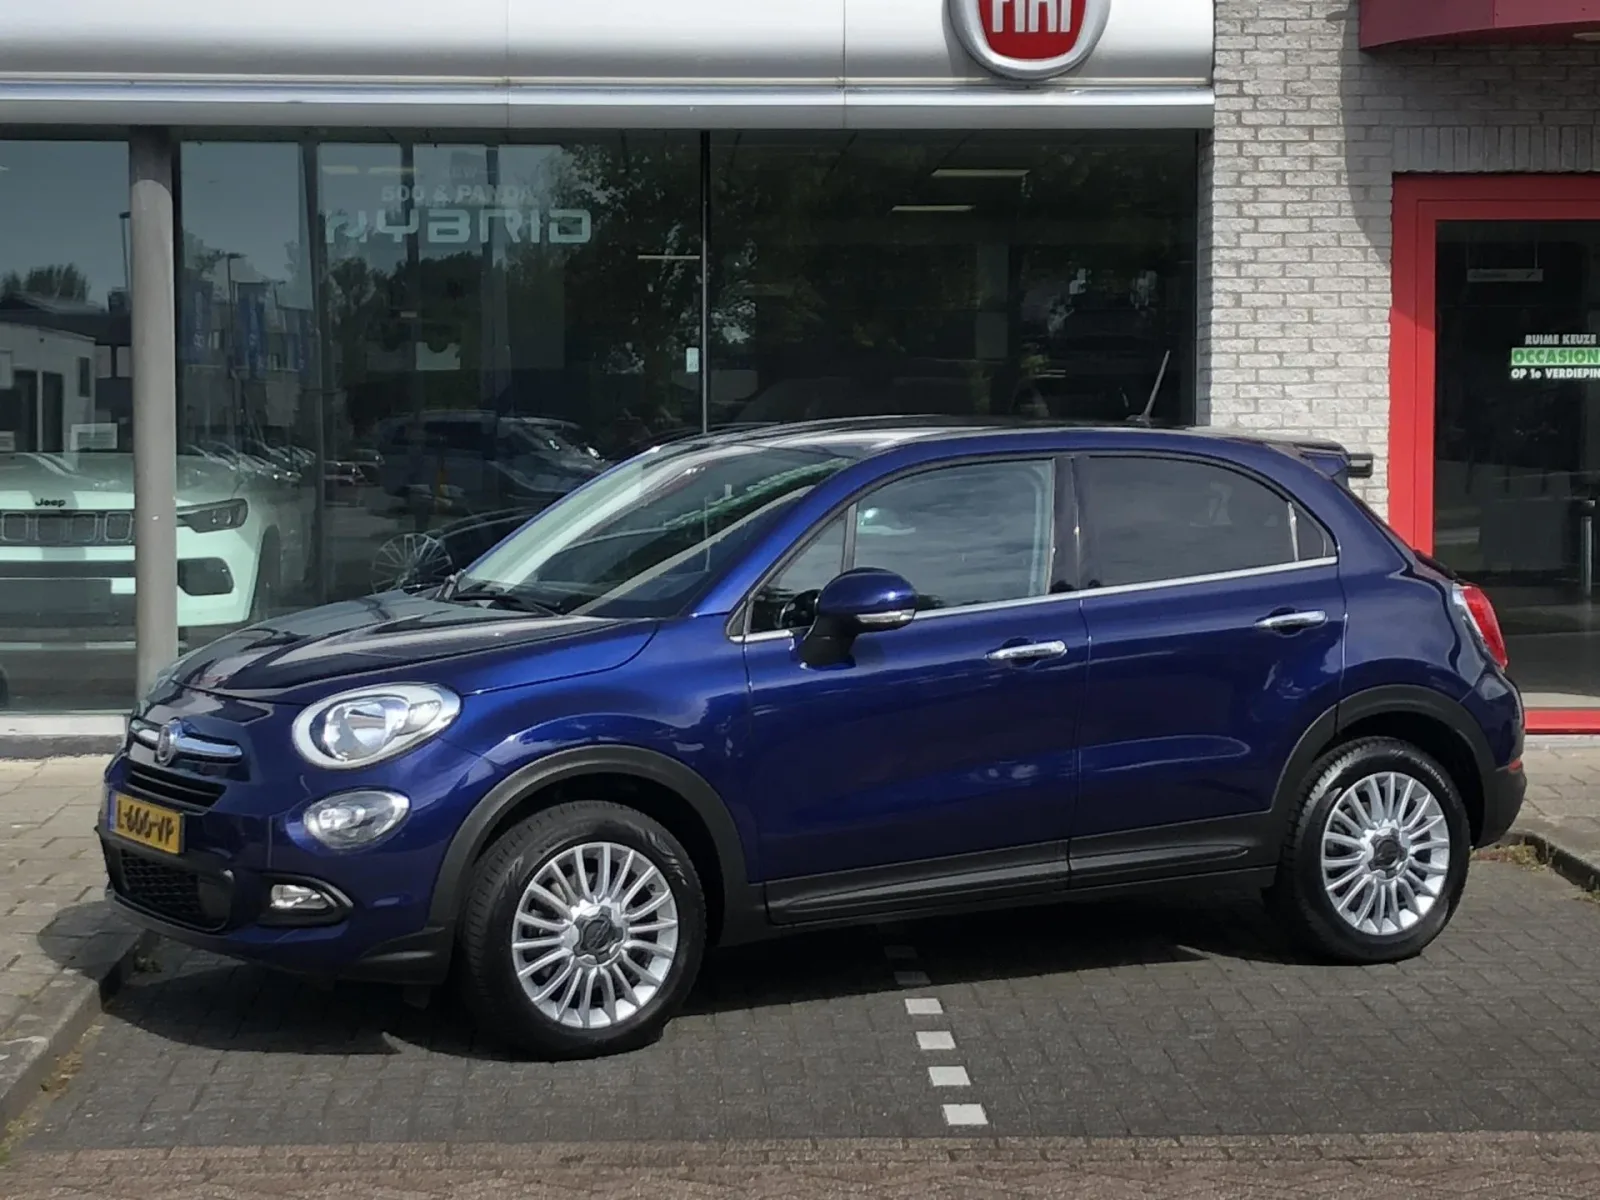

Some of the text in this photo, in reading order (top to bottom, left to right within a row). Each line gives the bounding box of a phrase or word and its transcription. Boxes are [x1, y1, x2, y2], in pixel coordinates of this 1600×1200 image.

[381, 184, 426, 204] 500
[432, 184, 452, 204] &
[325, 209, 592, 244] HYBRID
[1525, 334, 1597, 345] RUIME KEUZE
[1511, 368, 1527, 379] OP
[35, 498, 66, 508] Jeep
